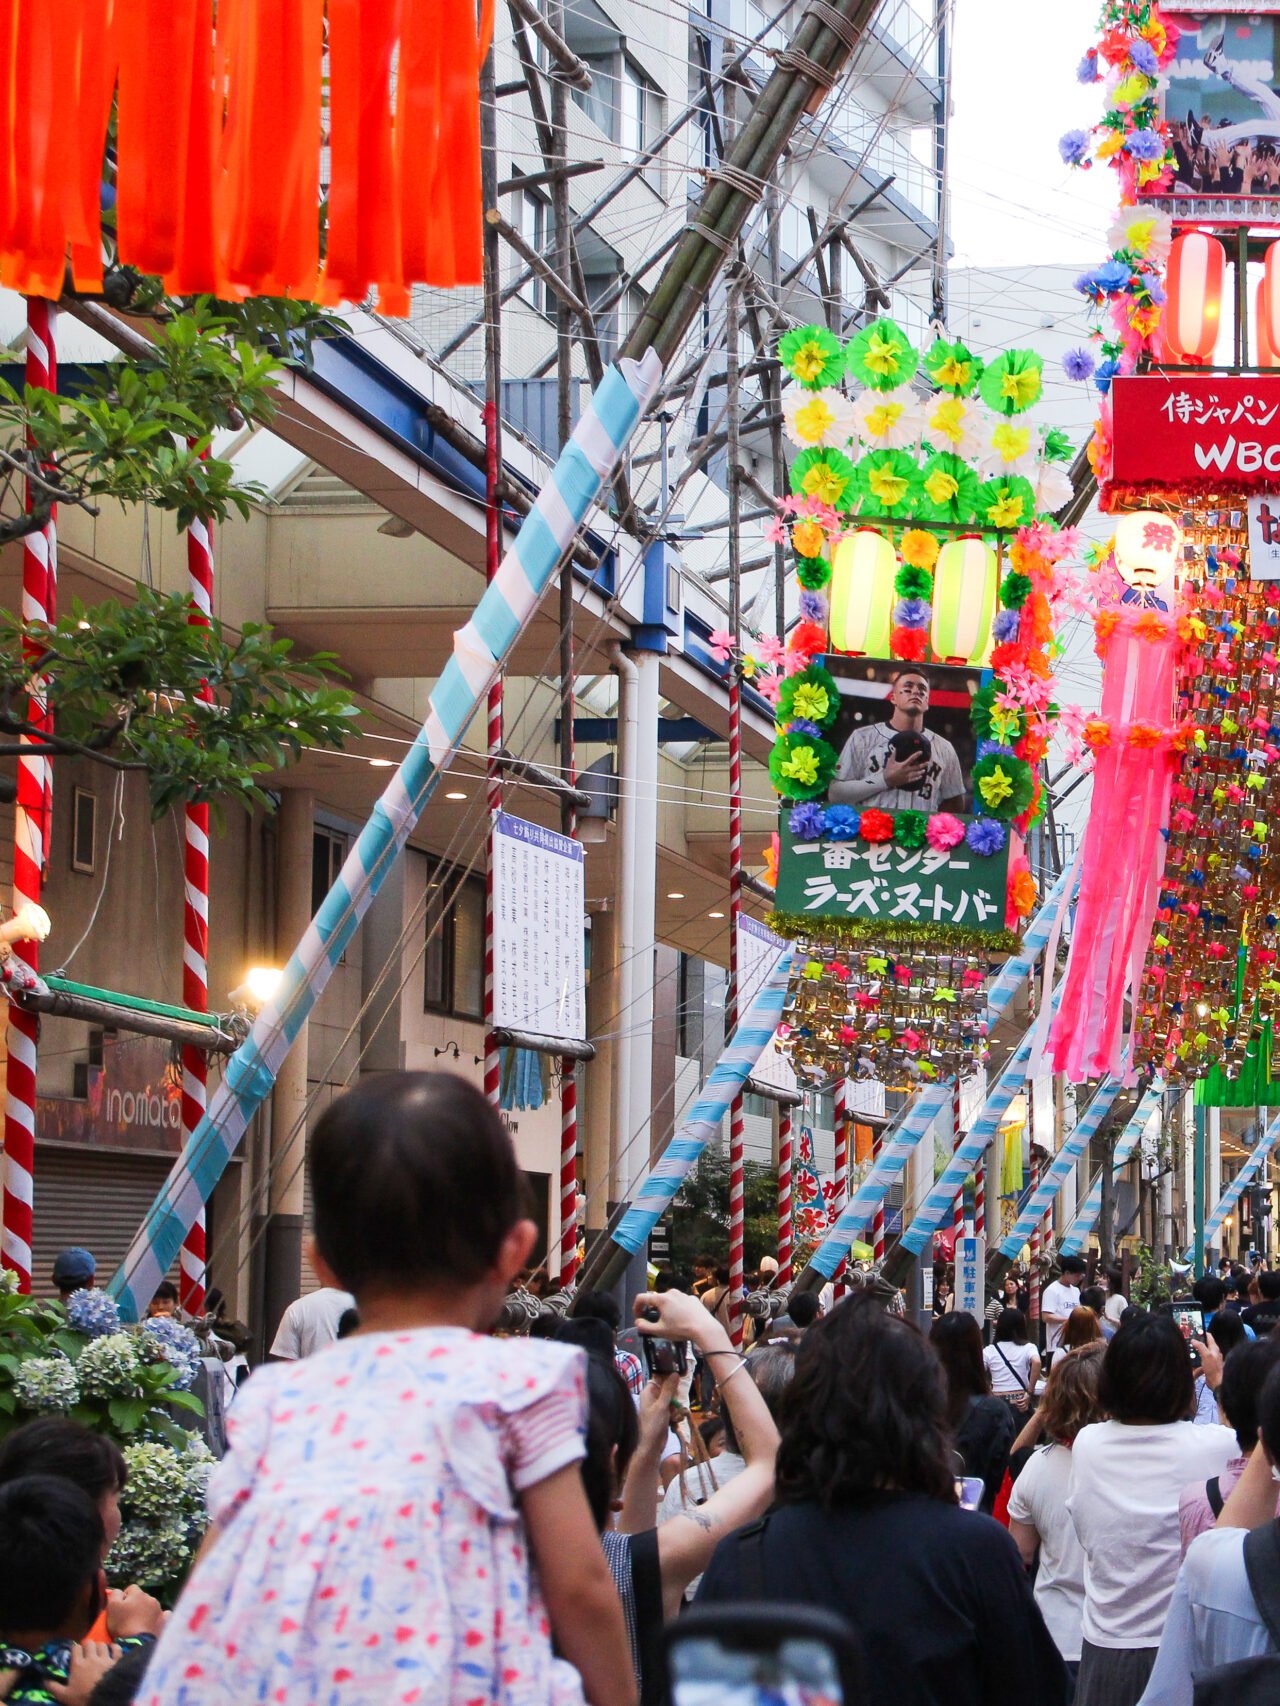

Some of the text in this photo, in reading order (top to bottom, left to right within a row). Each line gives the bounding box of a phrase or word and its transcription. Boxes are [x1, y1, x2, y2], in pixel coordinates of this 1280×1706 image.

[791, 841, 970, 875] 一番センター
